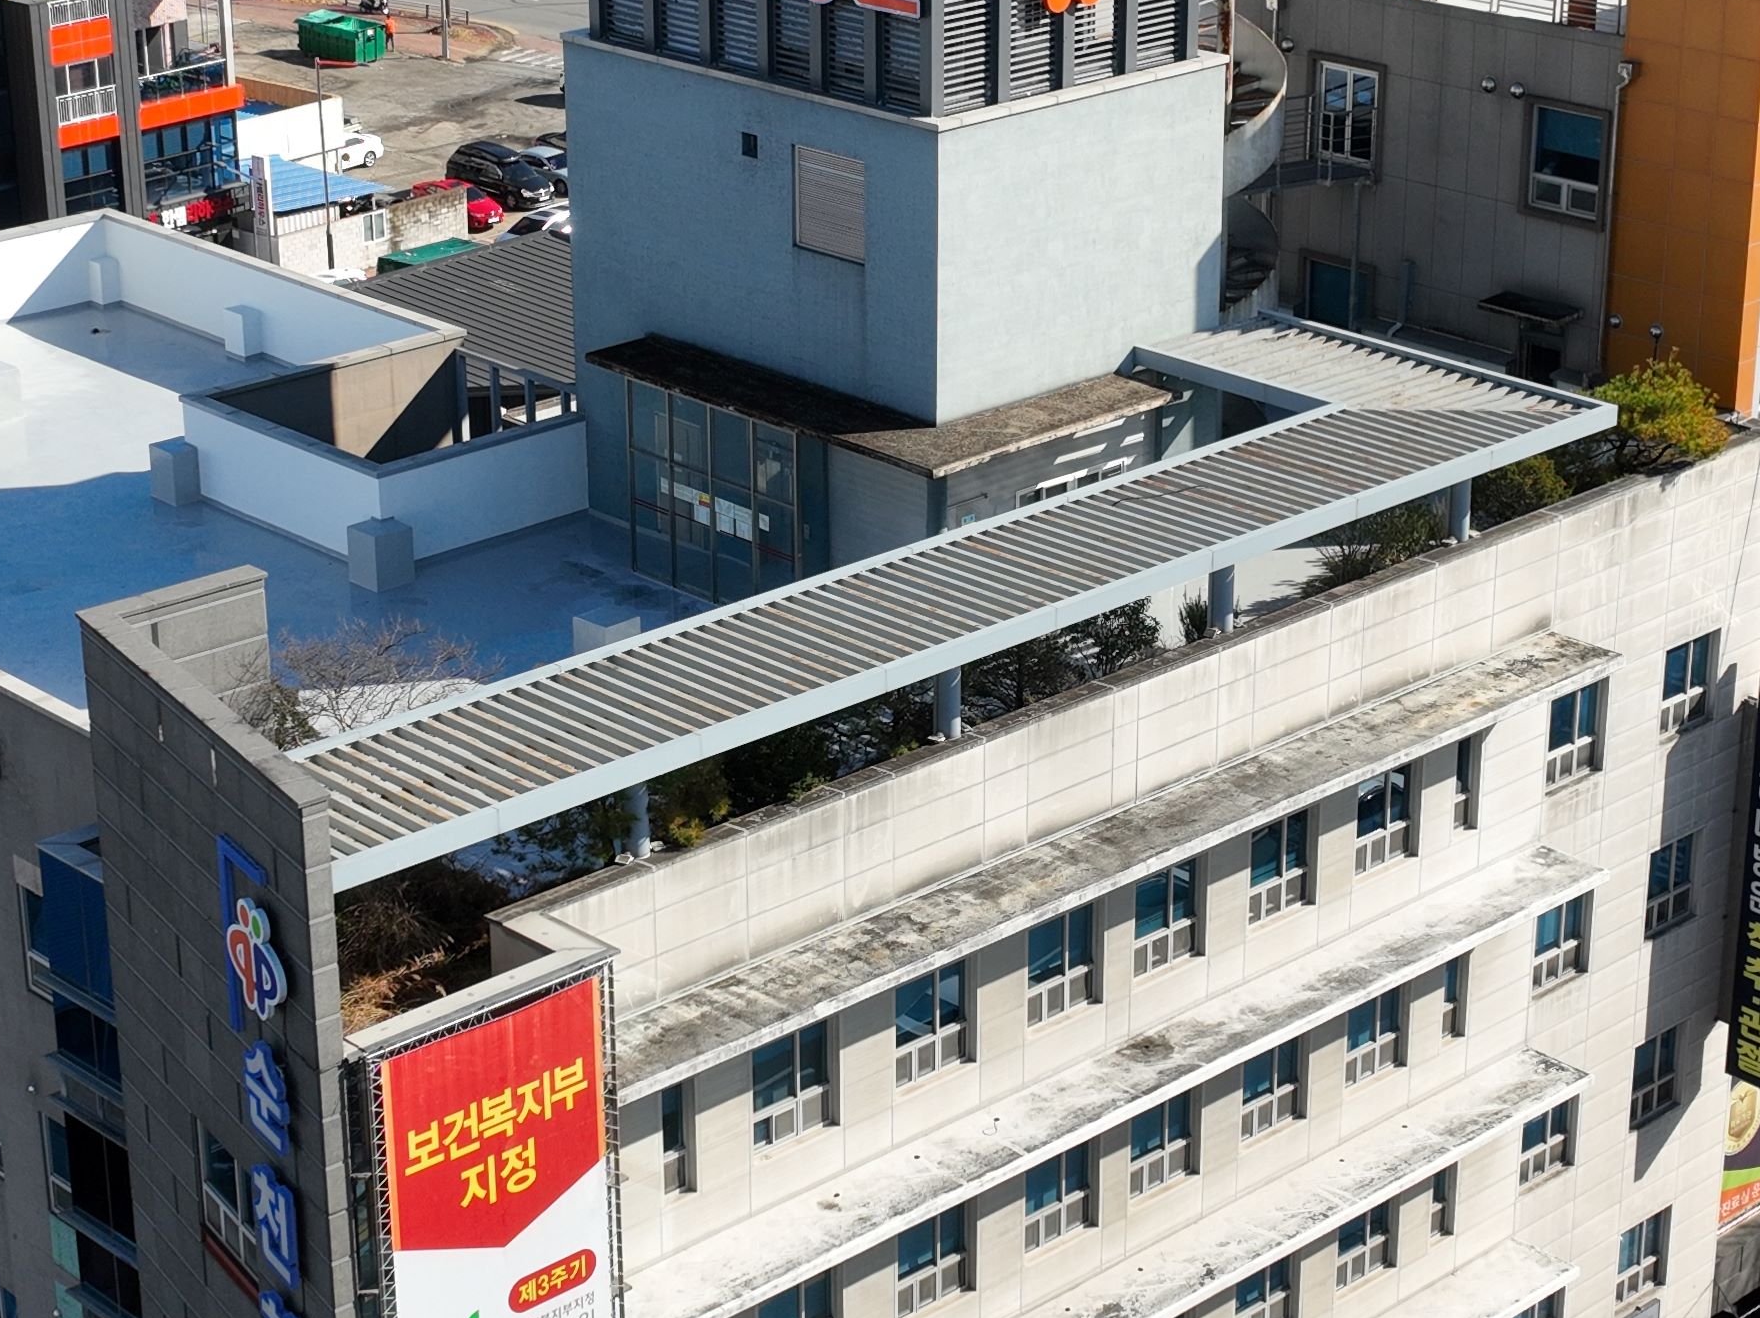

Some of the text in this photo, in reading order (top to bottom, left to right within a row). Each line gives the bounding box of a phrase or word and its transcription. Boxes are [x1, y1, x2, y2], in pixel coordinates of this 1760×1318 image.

[404, 1057, 588, 1176] 보건복지부
[460, 1137, 537, 1208] 지정
[1720, 1187, 1751, 1218] 진료실
[518, 1255, 587, 1304] 제3주기
